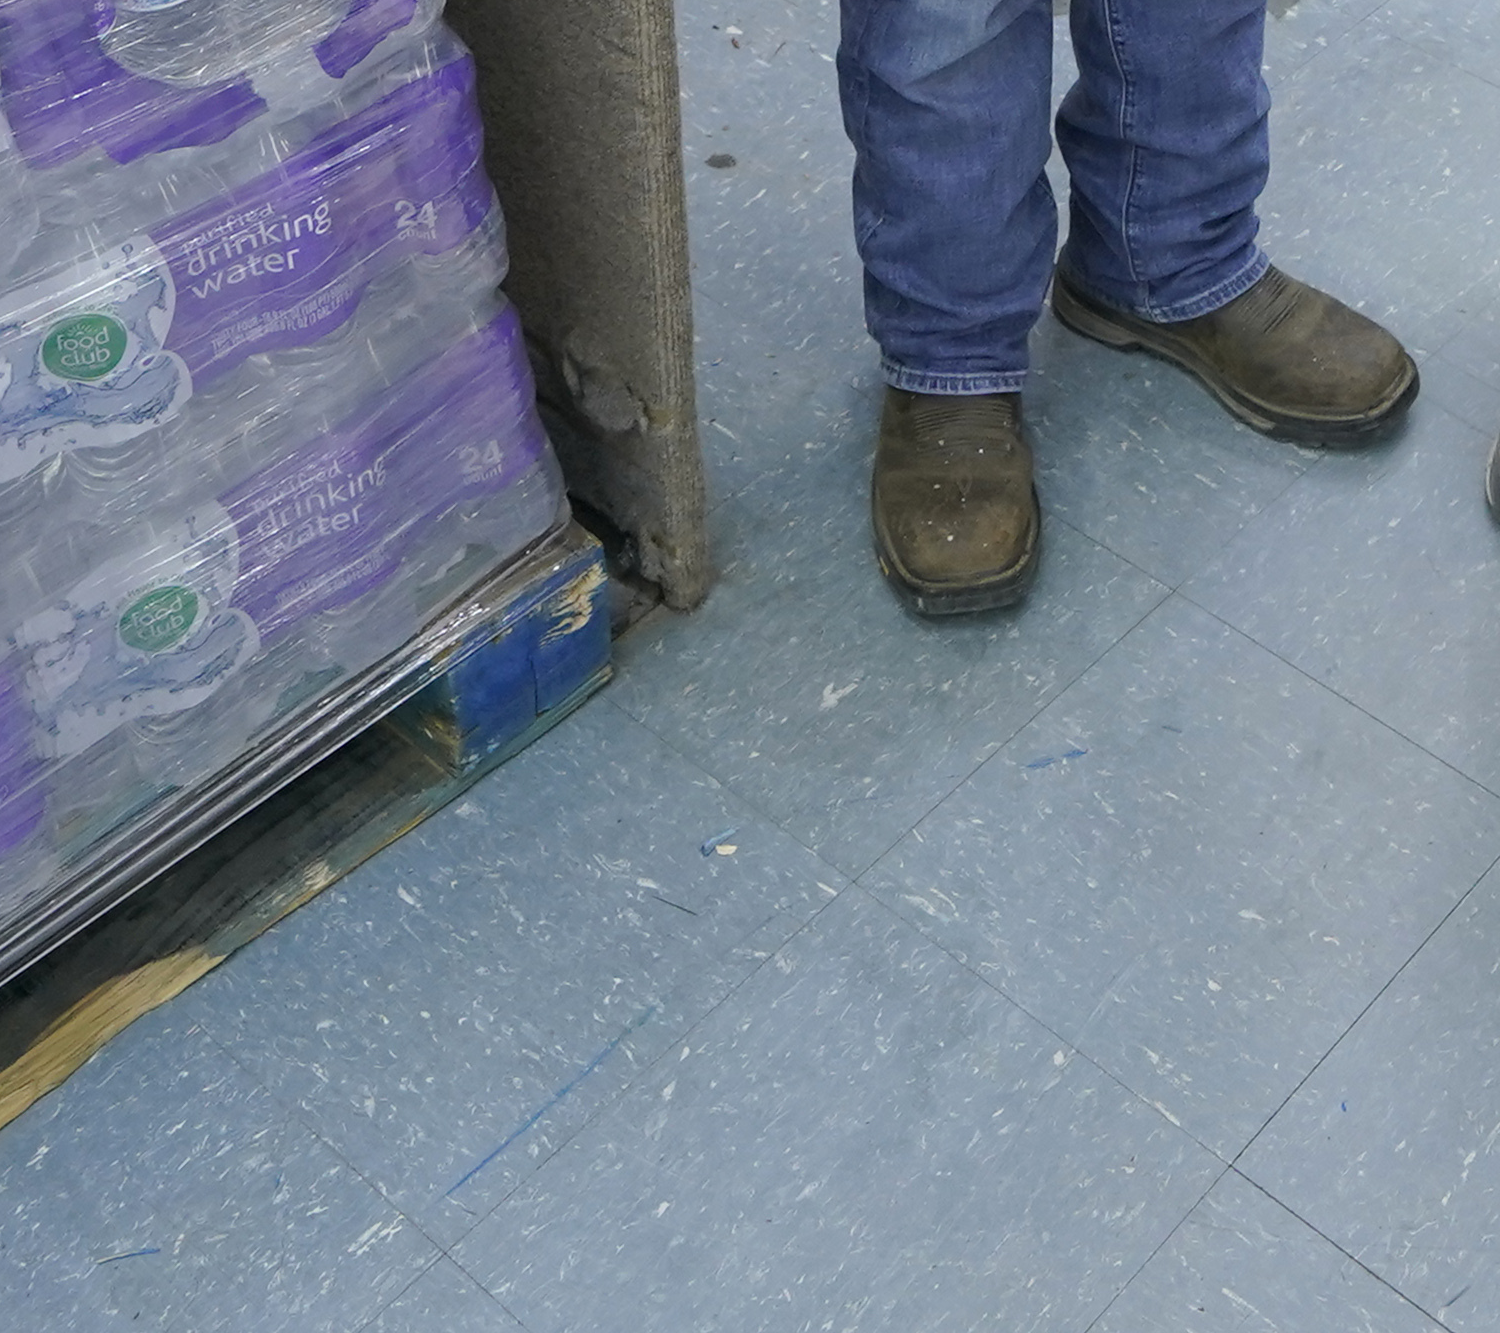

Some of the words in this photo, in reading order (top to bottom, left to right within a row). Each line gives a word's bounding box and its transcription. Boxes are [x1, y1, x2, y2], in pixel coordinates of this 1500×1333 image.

[393, 199, 438, 232] 24
[187, 201, 332, 278] drinking
[192, 245, 300, 301] water
[56, 323, 111, 354] food
[60, 341, 111, 366] club
[459, 439, 504, 477] 24
